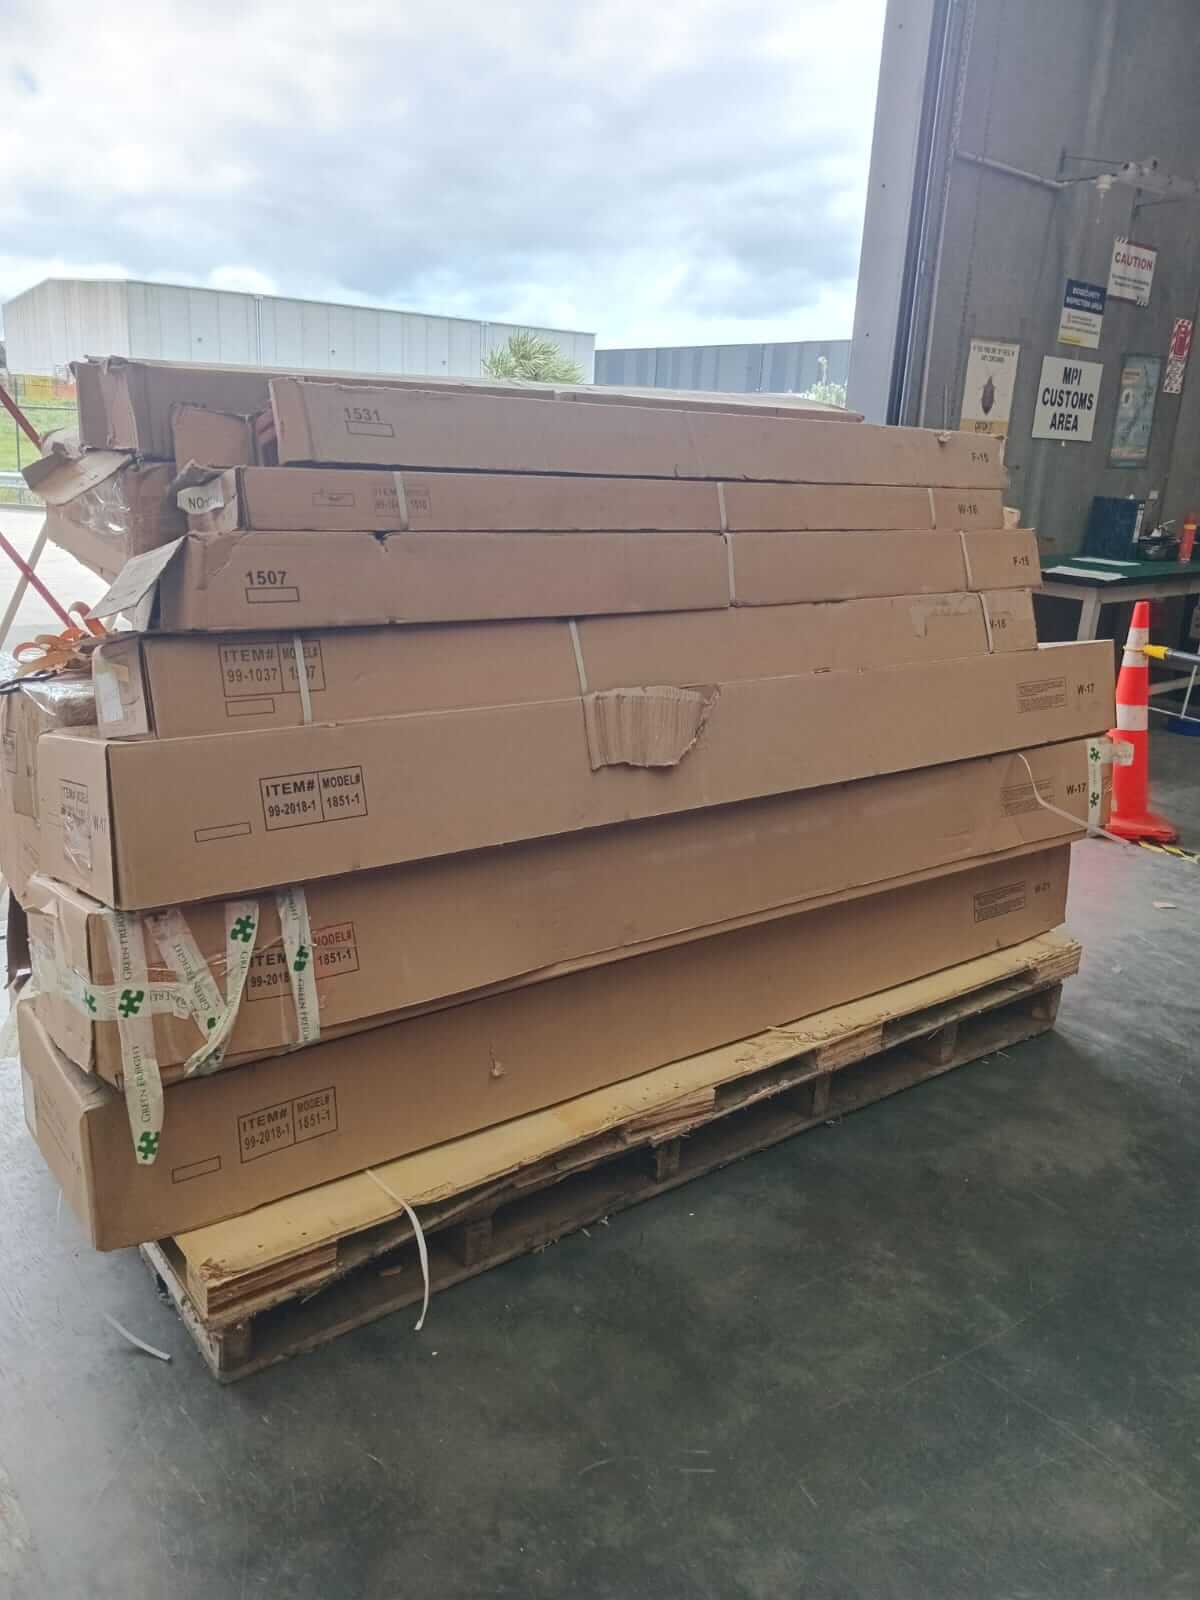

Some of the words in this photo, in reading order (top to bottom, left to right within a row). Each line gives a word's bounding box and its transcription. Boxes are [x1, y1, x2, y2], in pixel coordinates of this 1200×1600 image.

[1114, 251, 1153, 271] CAUTION
[1062, 366, 1082, 386] MPI
[1042, 388, 1095, 411] CUSTOMS
[344, 409, 381, 422] 1531
[1049, 411, 1079, 432] AREA
[245, 570, 289, 585] 1507
[223, 647, 274, 662] ITEM#
[226, 667, 278, 683] 99-1037
[265, 779, 315, 798] ITEM#
[322, 773, 361, 789] MODEL#
[268, 799, 317, 817] 99-2018-1
[327, 792, 361, 809] 1851-1
[319, 949, 352, 967] 1851-1
[242, 1107, 287, 1132] ITEM#
[244, 1122, 290, 1150] 99-2018-1
